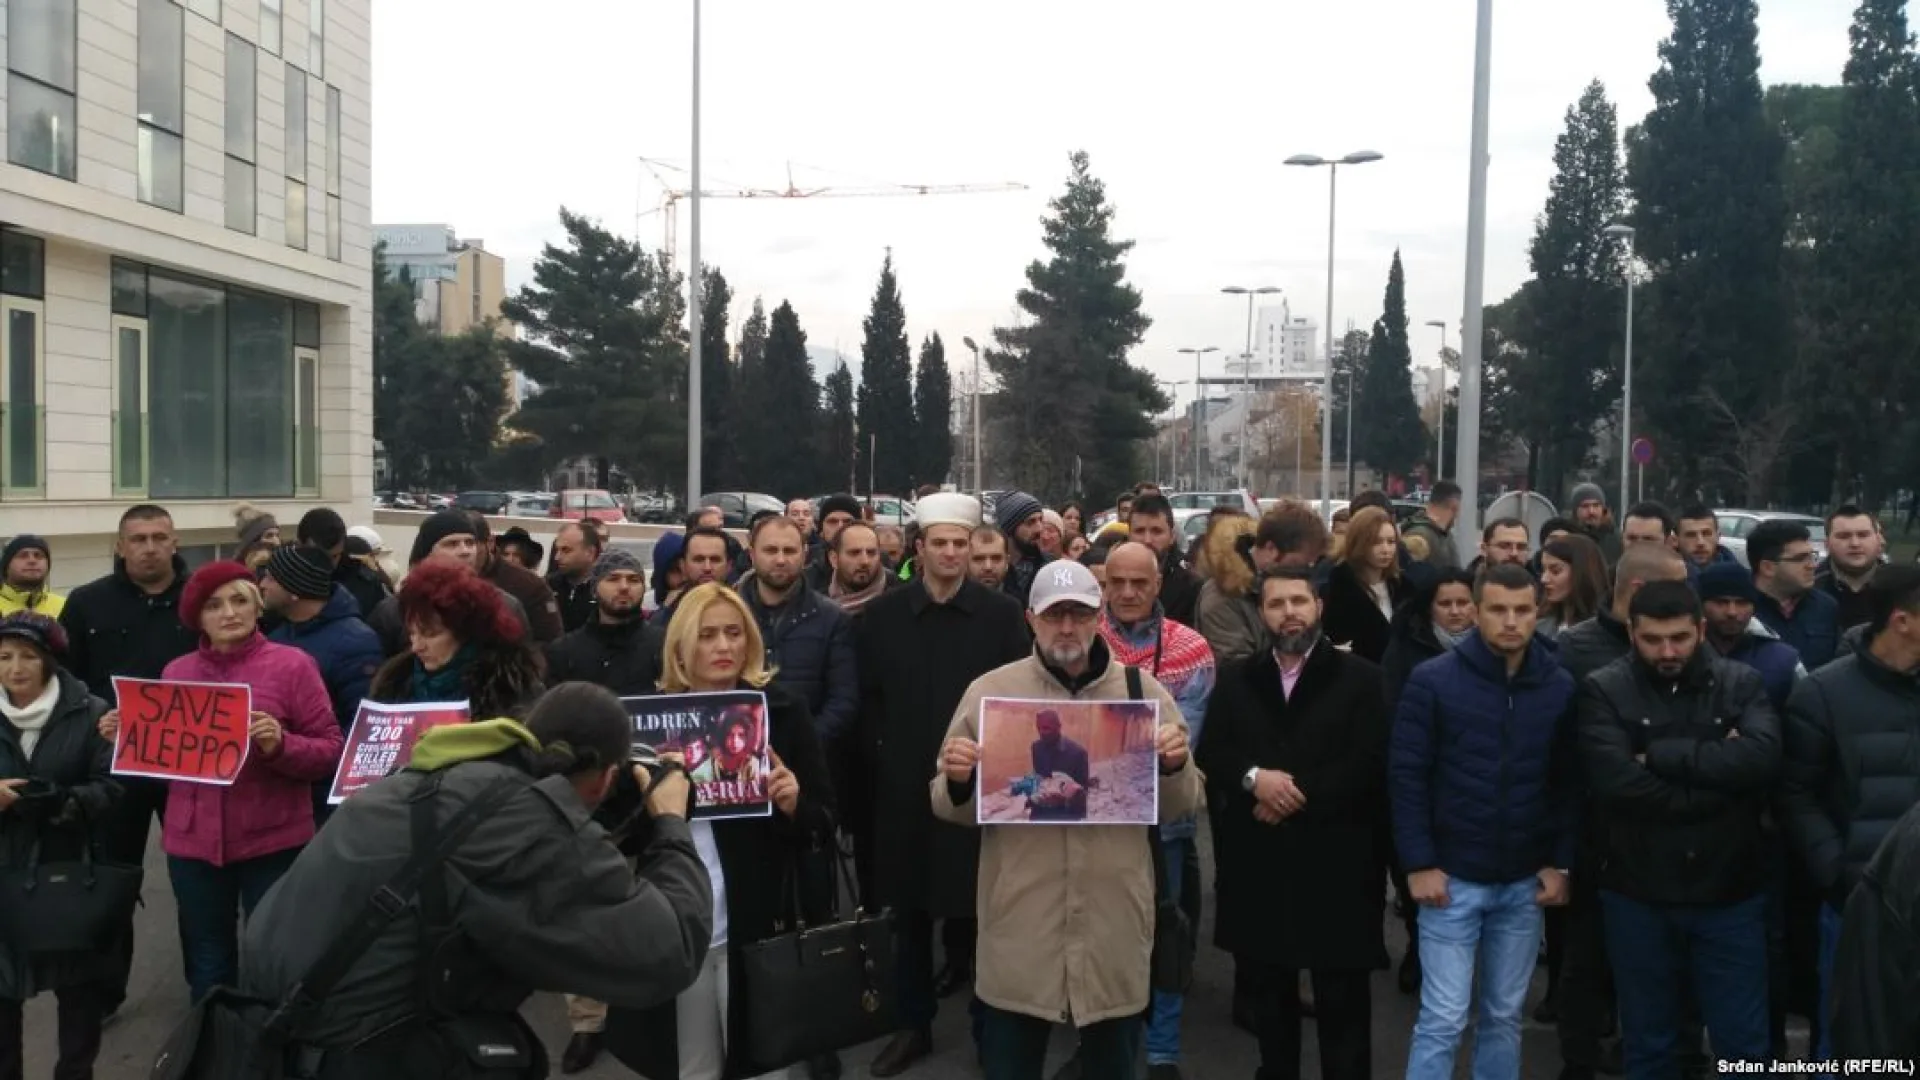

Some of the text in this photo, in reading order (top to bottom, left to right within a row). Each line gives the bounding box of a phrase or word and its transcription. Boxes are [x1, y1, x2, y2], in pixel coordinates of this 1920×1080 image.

[1053, 568, 1073, 587] NY
[138, 684, 236, 731] SAVE
[368, 726, 403, 742] 200
[117, 720, 241, 779] ALEPPO
[353, 752, 397, 764] KILLED
